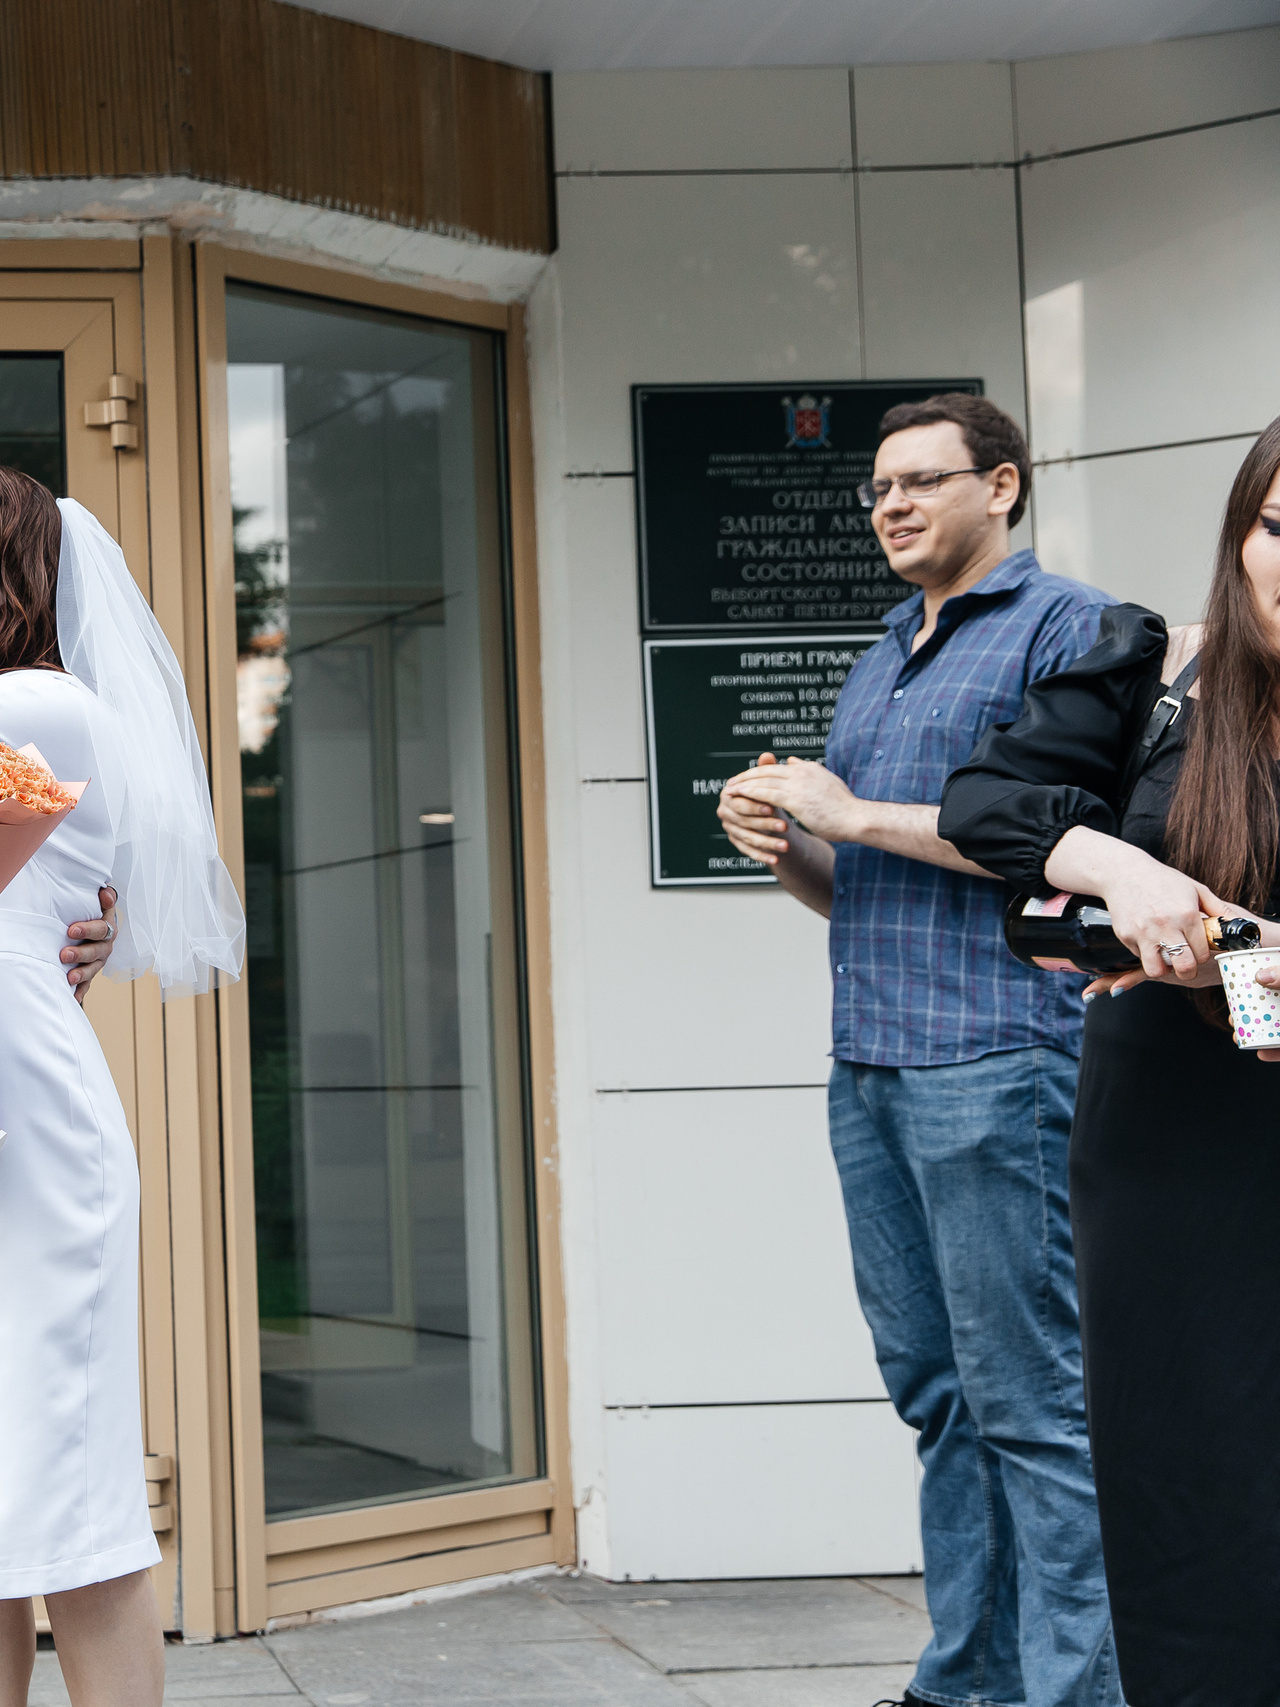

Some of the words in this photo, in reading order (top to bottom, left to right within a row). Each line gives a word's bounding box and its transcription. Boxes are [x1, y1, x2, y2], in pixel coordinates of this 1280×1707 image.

[772, 490, 853, 511] ОТДЕЛ
[719, 515, 816, 535] ЗАПИСИ
[829, 513, 872, 533] АКТ
[717, 537, 885, 559] ГРАЖДАНСКО
[741, 561, 889, 582] СОСТОЯНИЯ
[710, 586, 841, 602] ВЫБОРГСКОГО
[740, 651, 803, 668] ПРИЕМ
